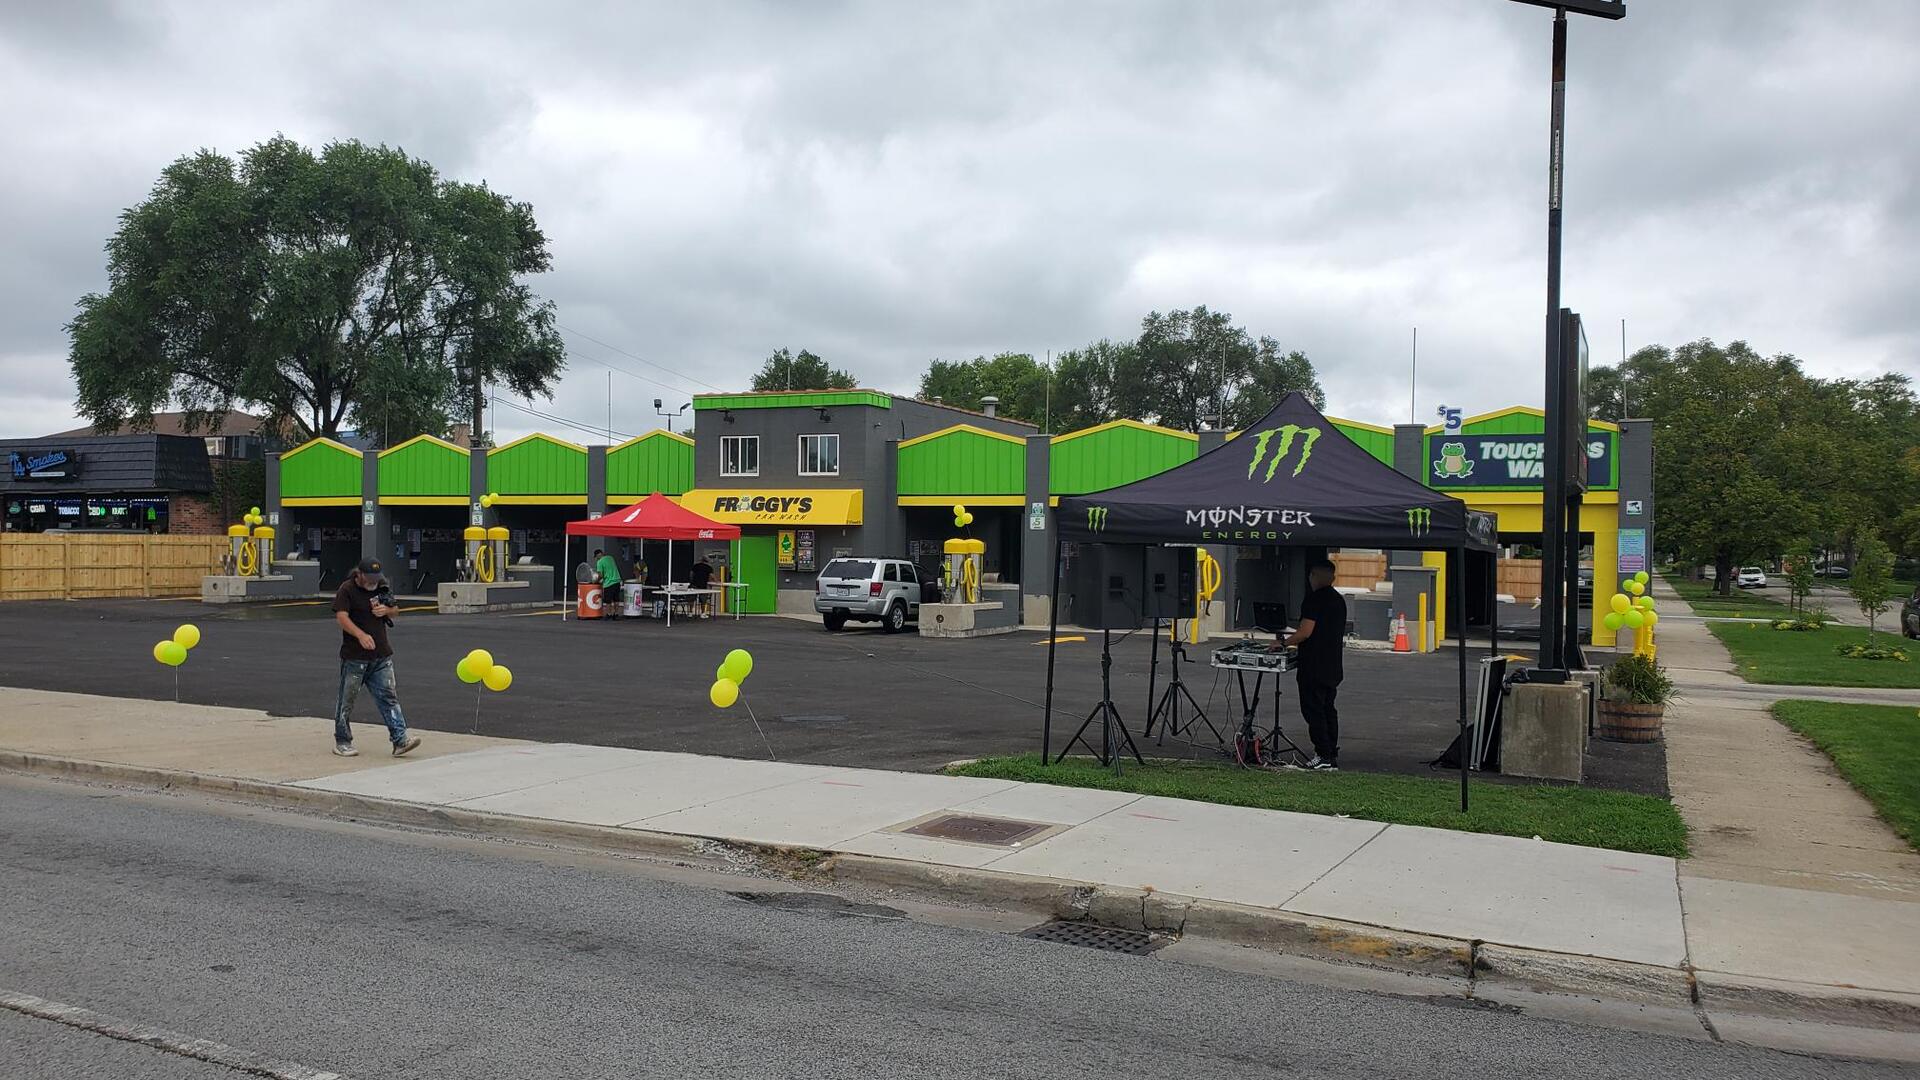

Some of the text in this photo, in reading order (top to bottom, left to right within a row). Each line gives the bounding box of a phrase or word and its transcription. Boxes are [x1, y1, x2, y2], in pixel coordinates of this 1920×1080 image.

[1439, 404, 1462, 430] $5
[1480, 441, 1606, 459] TOUCHS
[714, 496, 813, 513] FRGGY'S
[1185, 505, 1316, 528] MONSTER
[1202, 531, 1292, 540] ENERGY
